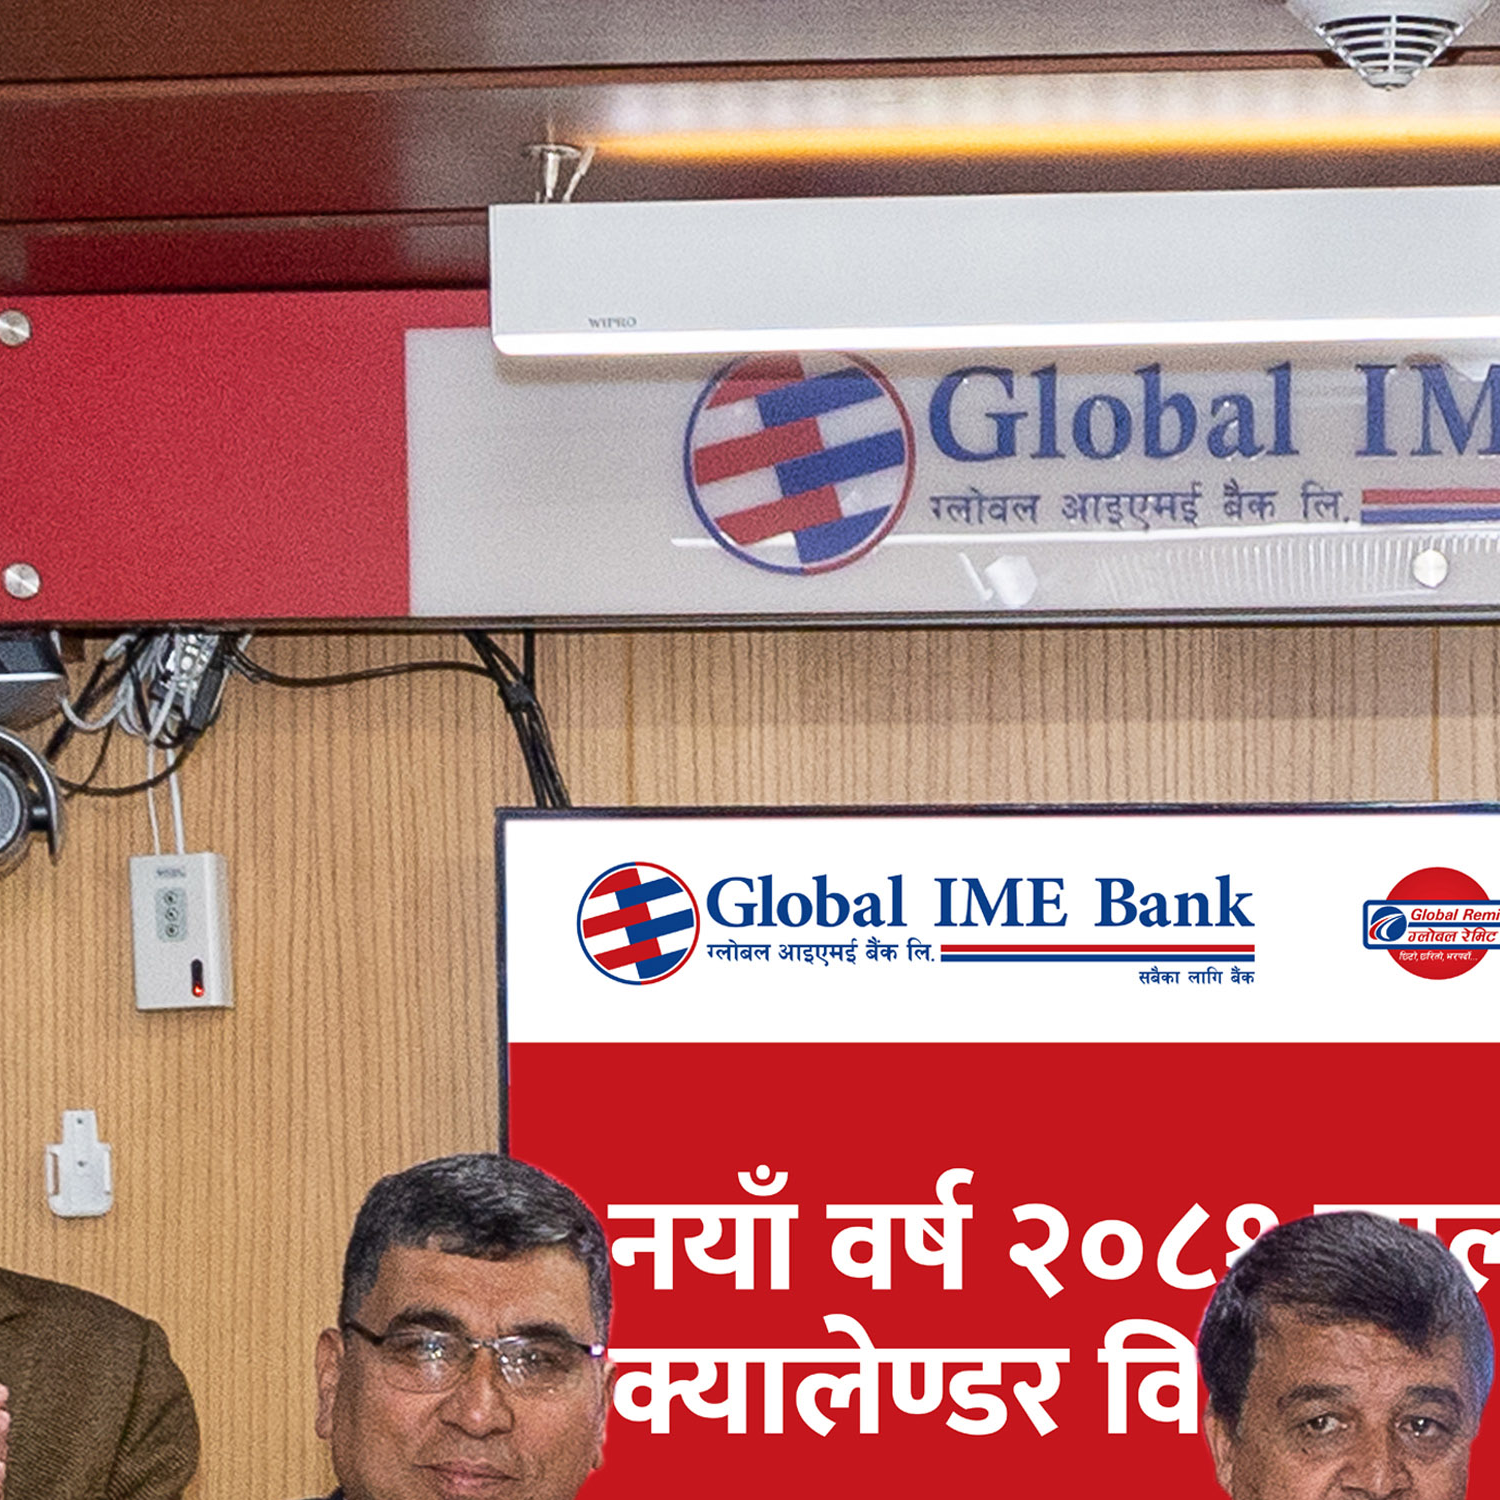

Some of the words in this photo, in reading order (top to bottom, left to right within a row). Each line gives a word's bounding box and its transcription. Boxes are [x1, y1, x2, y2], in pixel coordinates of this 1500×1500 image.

[928, 361, 1300, 463] Global
[1062, 480, 1203, 531] आइएमई
[1301, 480, 1350, 522] लि.
[707, 874, 907, 928] Global
[934, 876, 1068, 928] IME
[1095, 874, 1255, 928] Bank
[1411, 908, 1459, 921] Global
[707, 938, 769, 962] ग्लोबल
[779, 938, 856, 966] आइएमई
[866, 937, 898, 962] बैंक
[907, 937, 935, 962] लि.
[1408, 928, 1459, 942] ग्लोबल
[1461, 927, 1499, 942] रेमिट
[1138, 966, 1180, 984] सबैका
[1188, 966, 1222, 984] लागि
[1231, 966, 1255, 984] बैंक
[608, 1165, 796, 1291] नयाँ
[826, 1169, 977, 1292] वर्ष
[611, 1314, 1070, 1437] क्यालेण्डर
